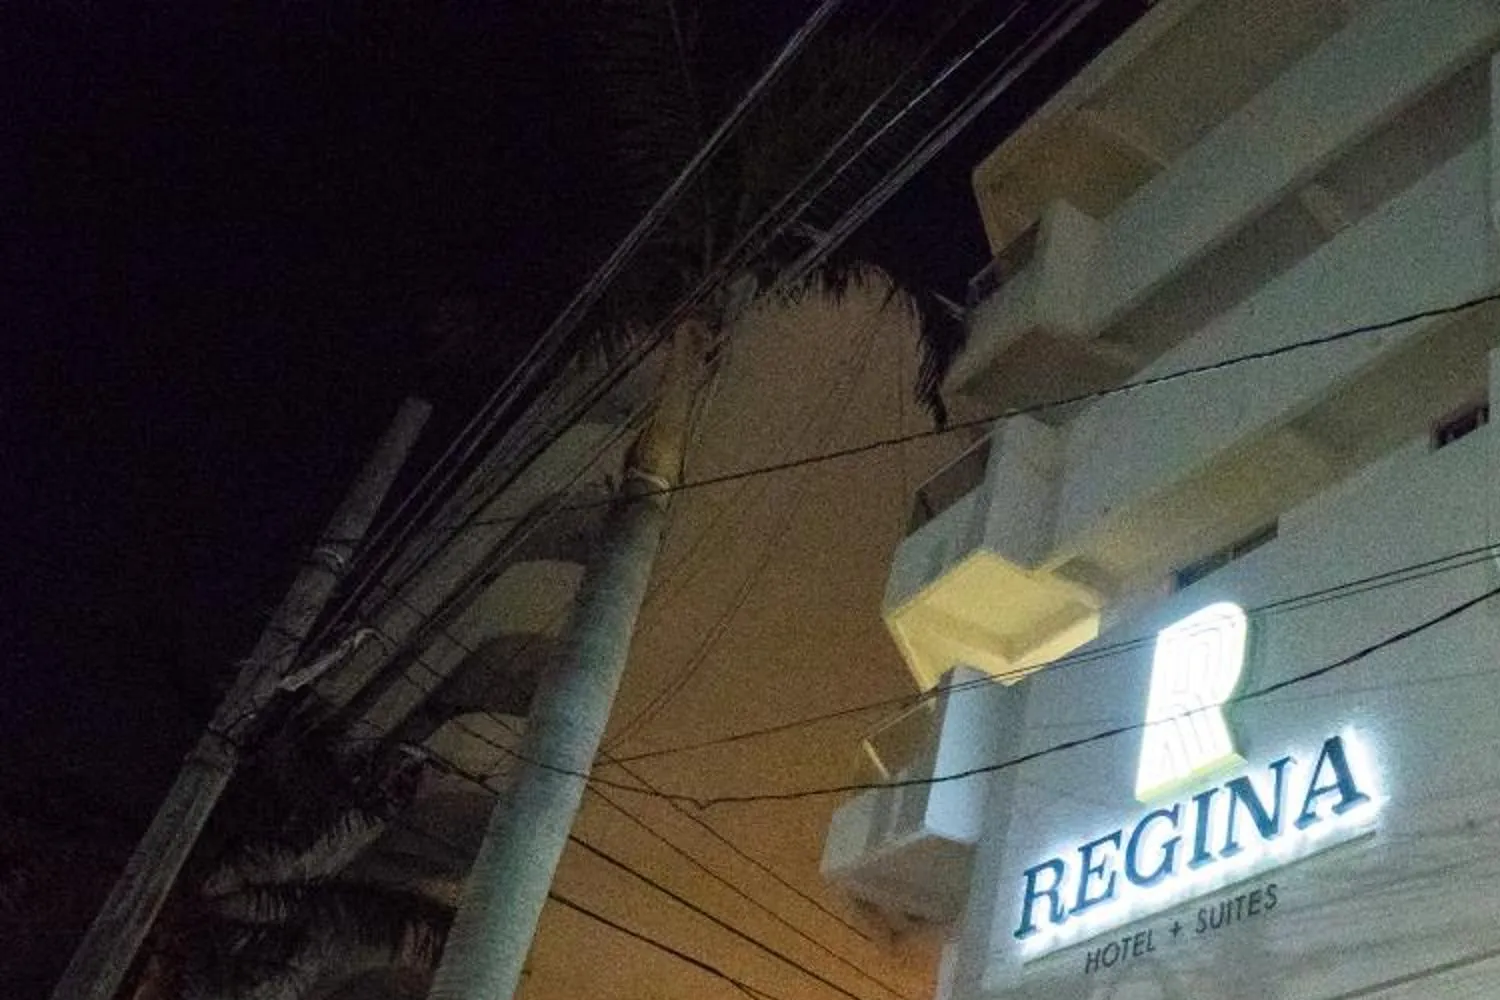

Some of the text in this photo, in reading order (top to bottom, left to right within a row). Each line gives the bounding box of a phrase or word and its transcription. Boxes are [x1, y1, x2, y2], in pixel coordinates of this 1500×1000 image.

[1014, 735, 1370, 940] REGINA
[1084, 929, 1156, 974] HOTEL
[1196, 884, 1279, 935] SUITES
